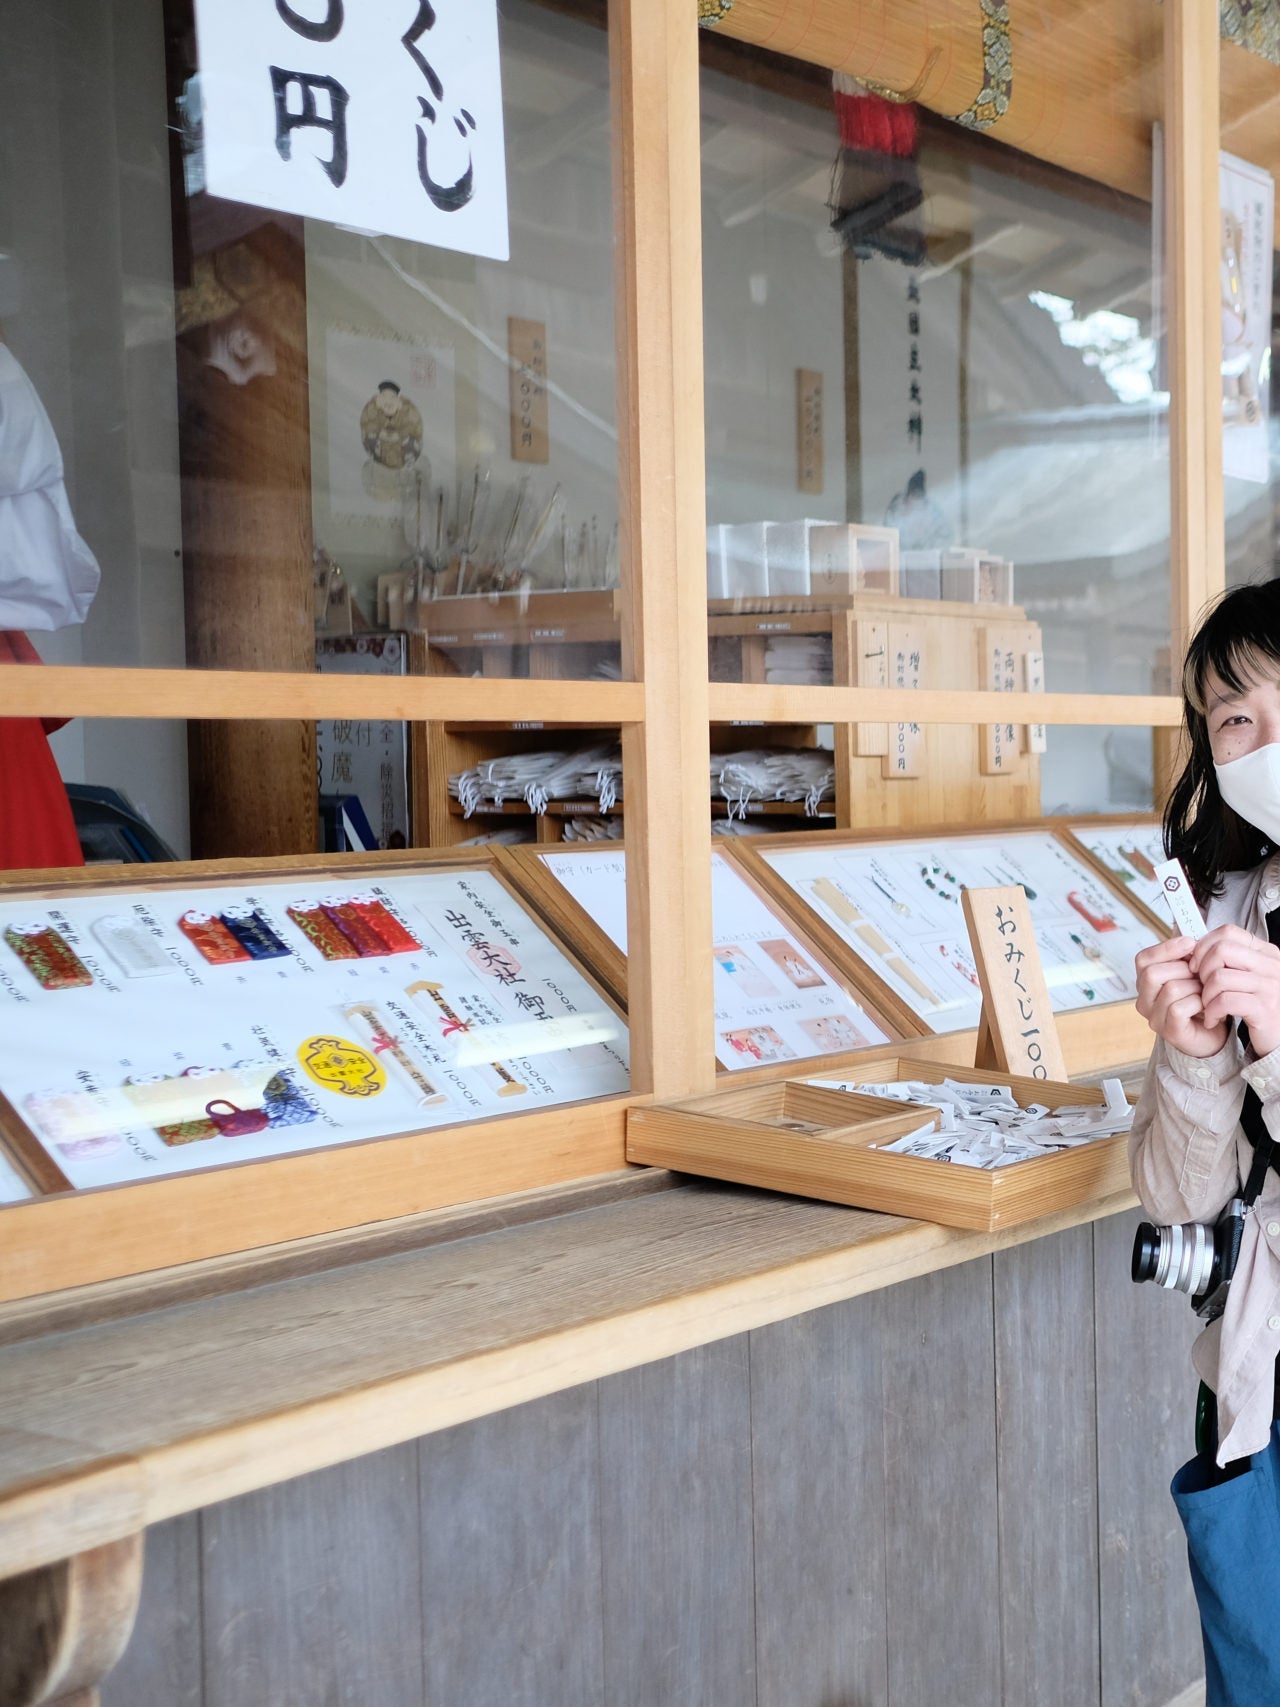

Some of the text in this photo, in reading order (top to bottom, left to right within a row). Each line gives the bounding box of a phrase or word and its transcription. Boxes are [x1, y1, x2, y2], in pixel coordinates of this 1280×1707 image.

[401, 0, 476, 212] くじ
[332, 720, 353, 796] 破魔
[445, 909, 526, 986] 出雲大社
